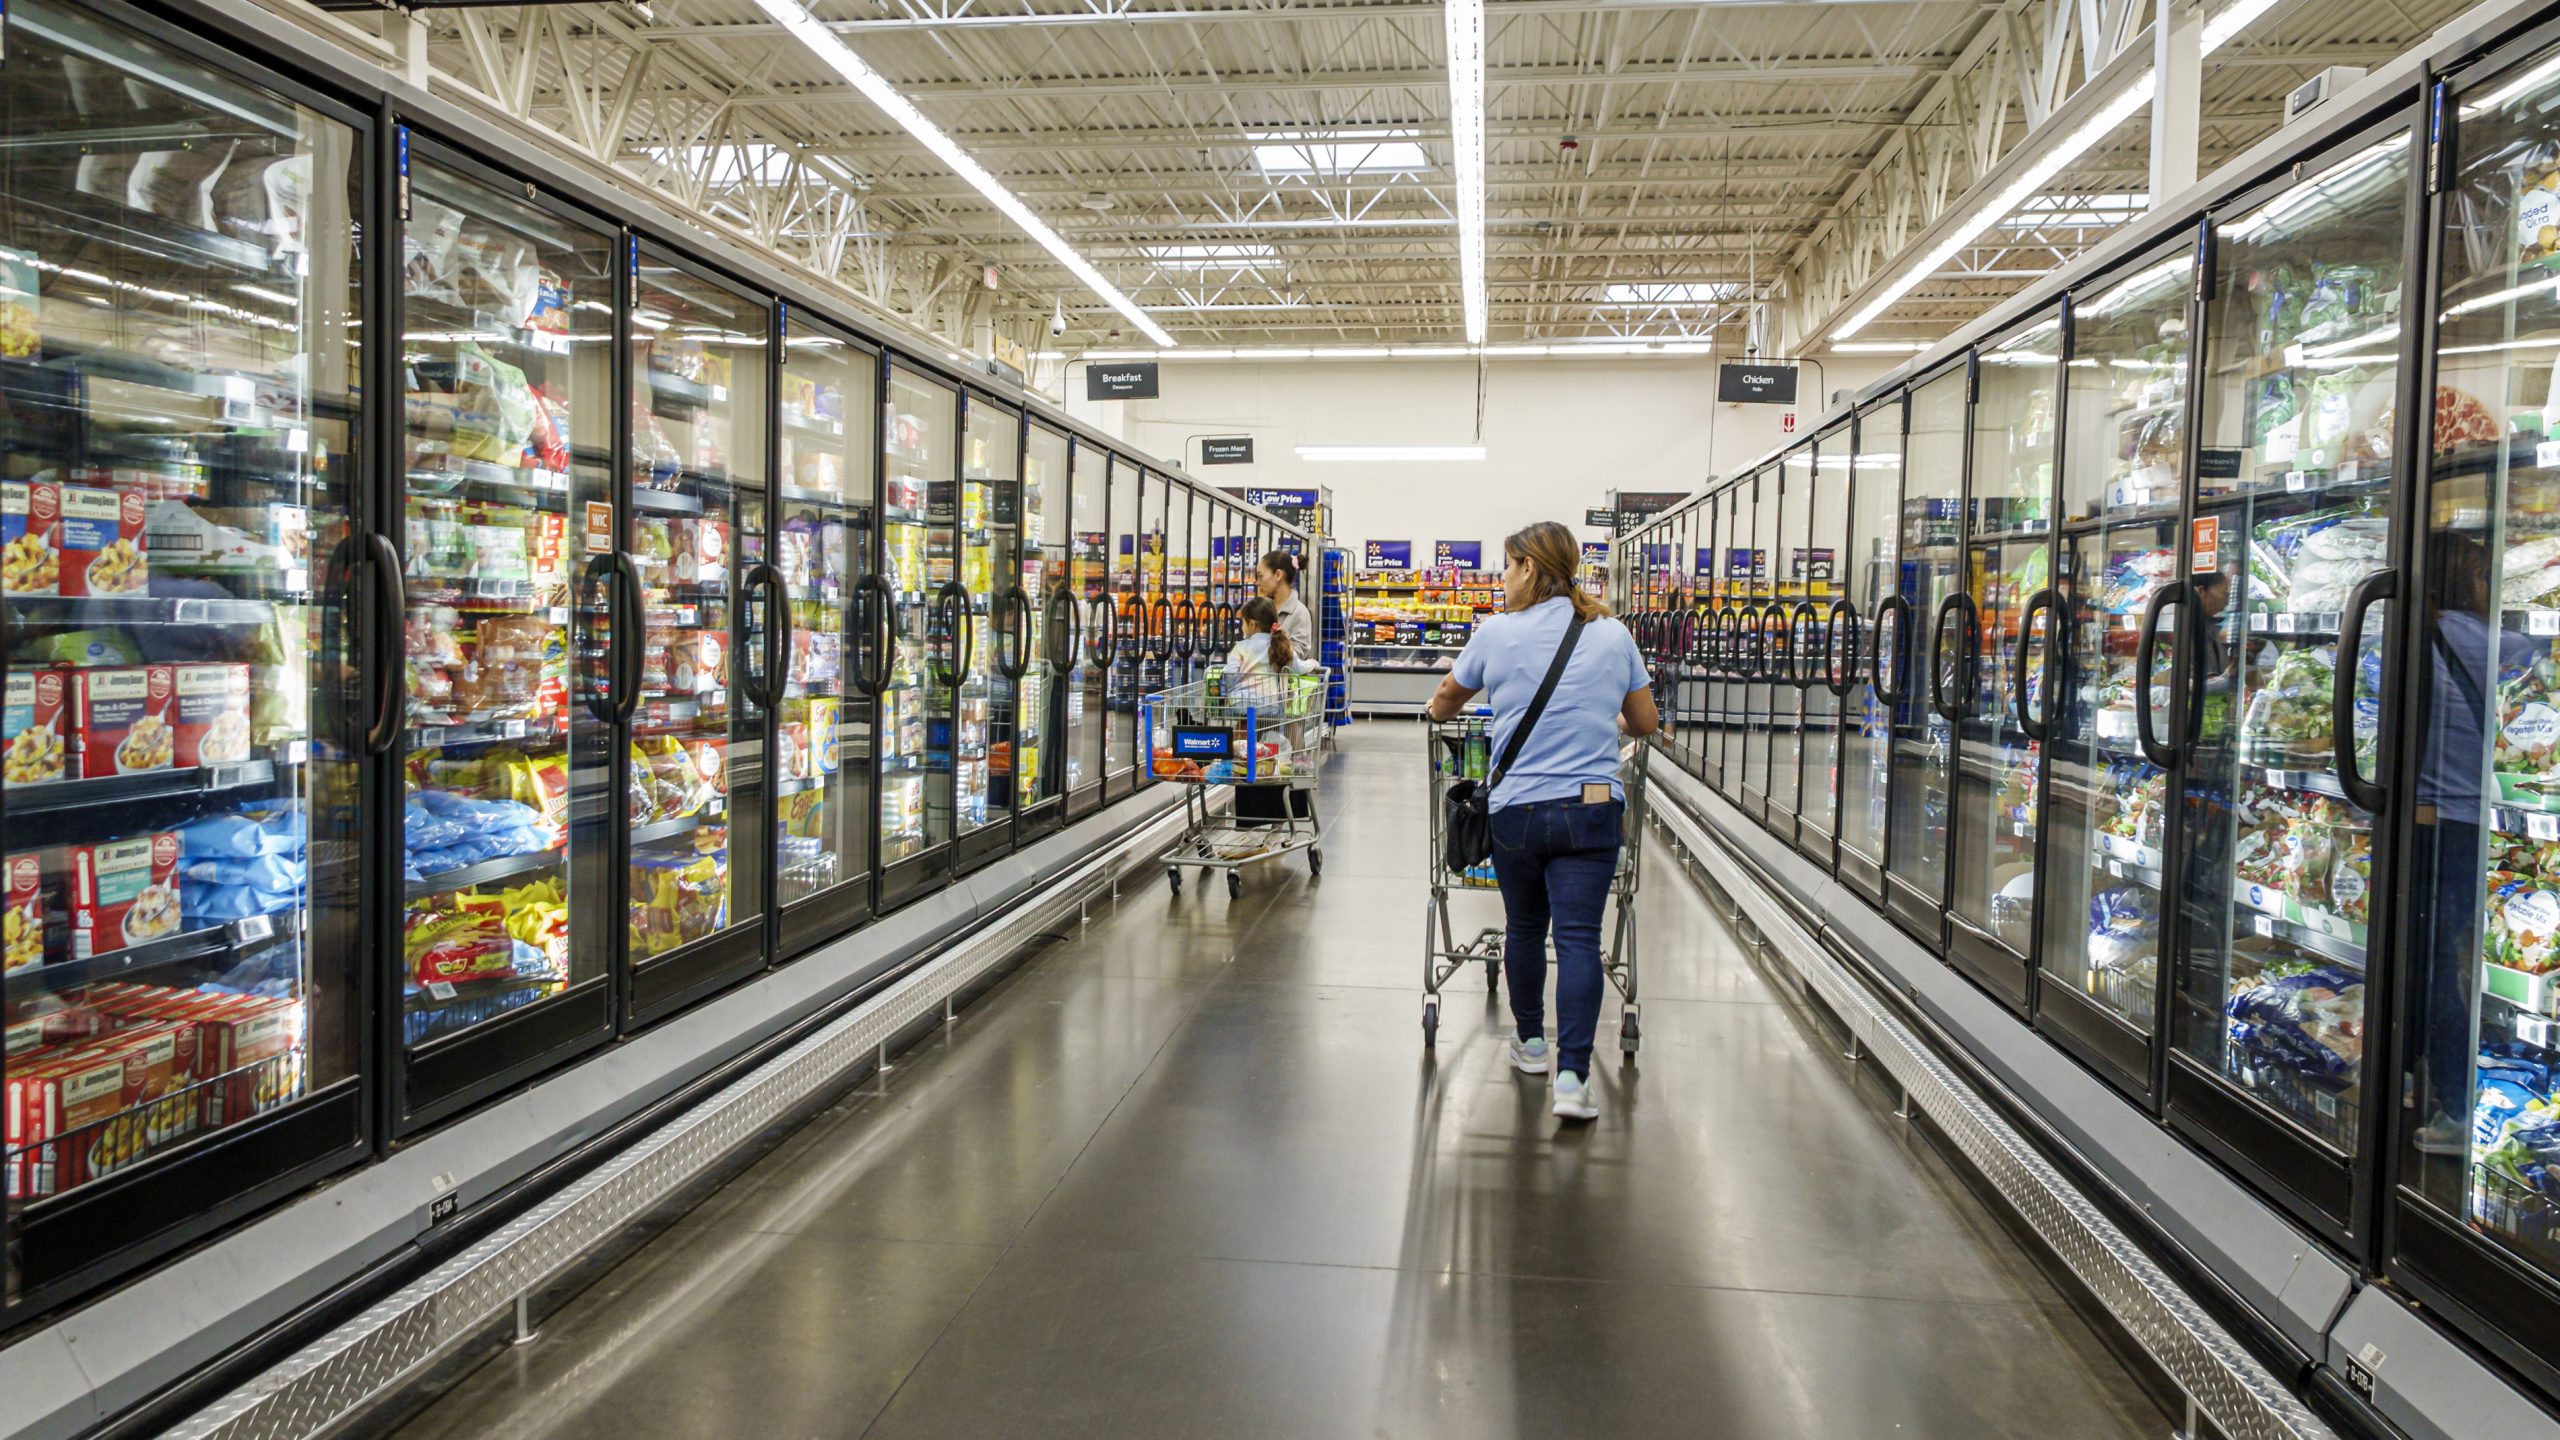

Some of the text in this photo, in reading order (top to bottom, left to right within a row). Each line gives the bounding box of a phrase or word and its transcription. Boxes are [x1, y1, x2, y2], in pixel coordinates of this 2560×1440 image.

[1102, 373, 1143, 383] Breakfast
[1742, 374, 1774, 384] Chicken
[1262, 494, 1302, 503] Low Price
[592, 513, 608, 528] WIC
[2199, 528, 2214, 544] WIC
[1454, 559, 1472, 567] Price
[1184, 738, 1211, 746] Walmart
